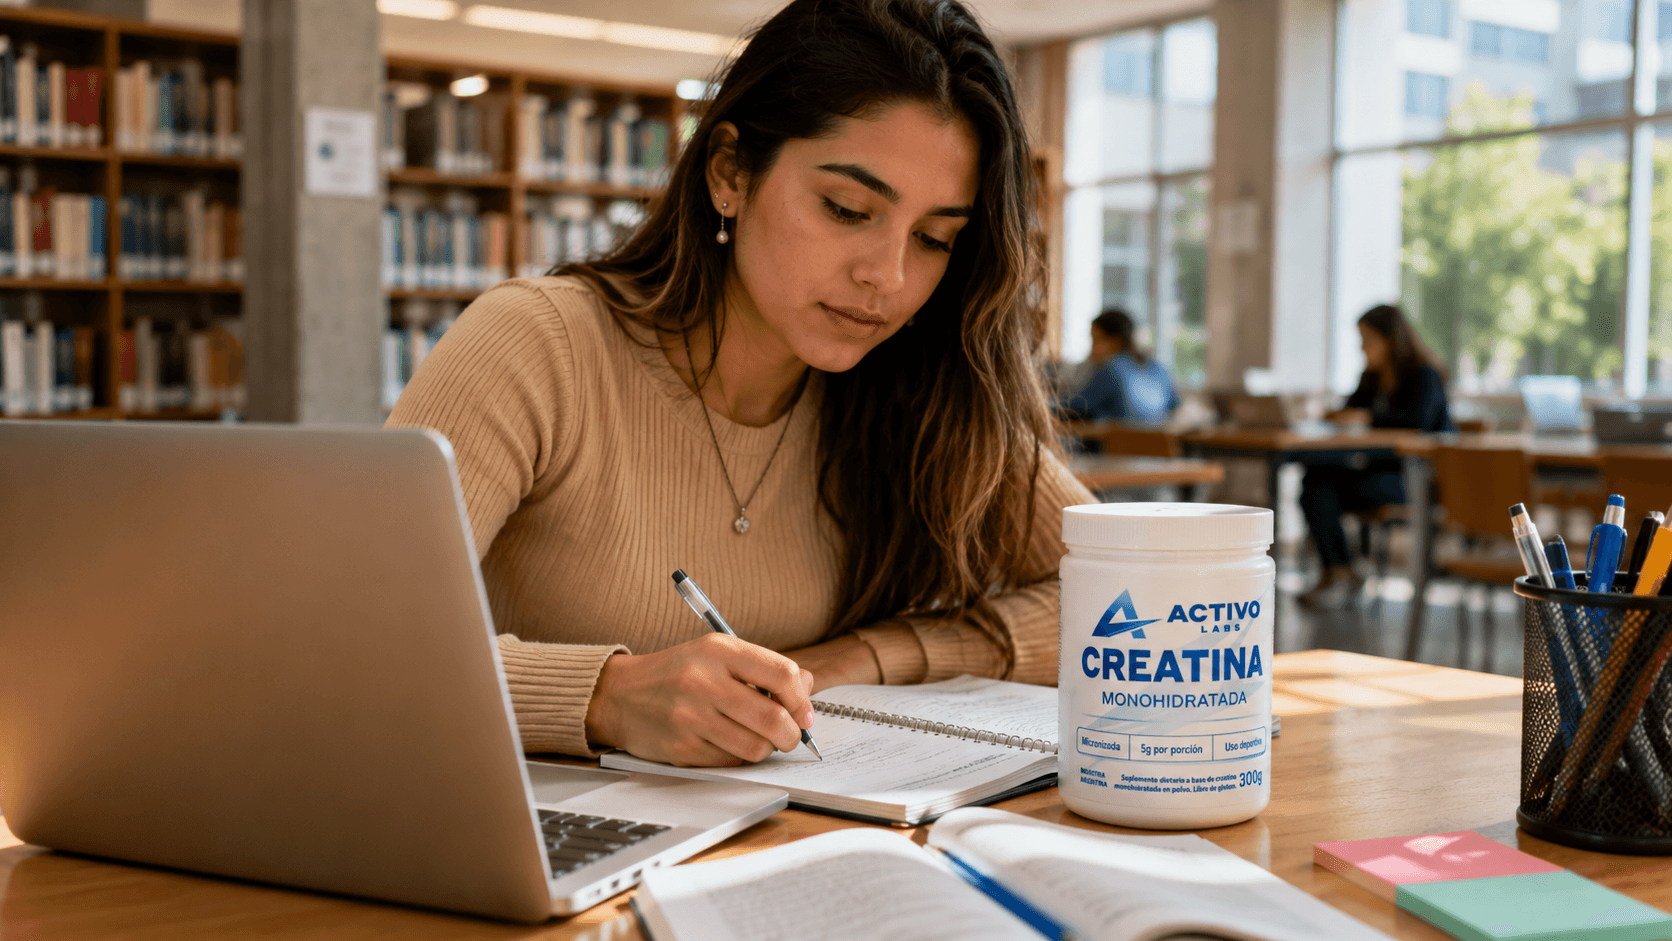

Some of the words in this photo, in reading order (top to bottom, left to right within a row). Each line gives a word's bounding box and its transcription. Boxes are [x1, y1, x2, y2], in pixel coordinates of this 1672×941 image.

[1167, 600, 1260, 623] ACTIVO
[1201, 624, 1240, 633] LABS
[1082, 644, 1263, 682] CREATINA
[1102, 691, 1247, 708] MONOHIDRATADA
[1141, 744, 1151, 756] 5g
[1154, 747, 1168, 756] por
[1170, 744, 1203, 756] porción
[1225, 742, 1238, 751] Uso
[1239, 769, 1262, 787] 300g
